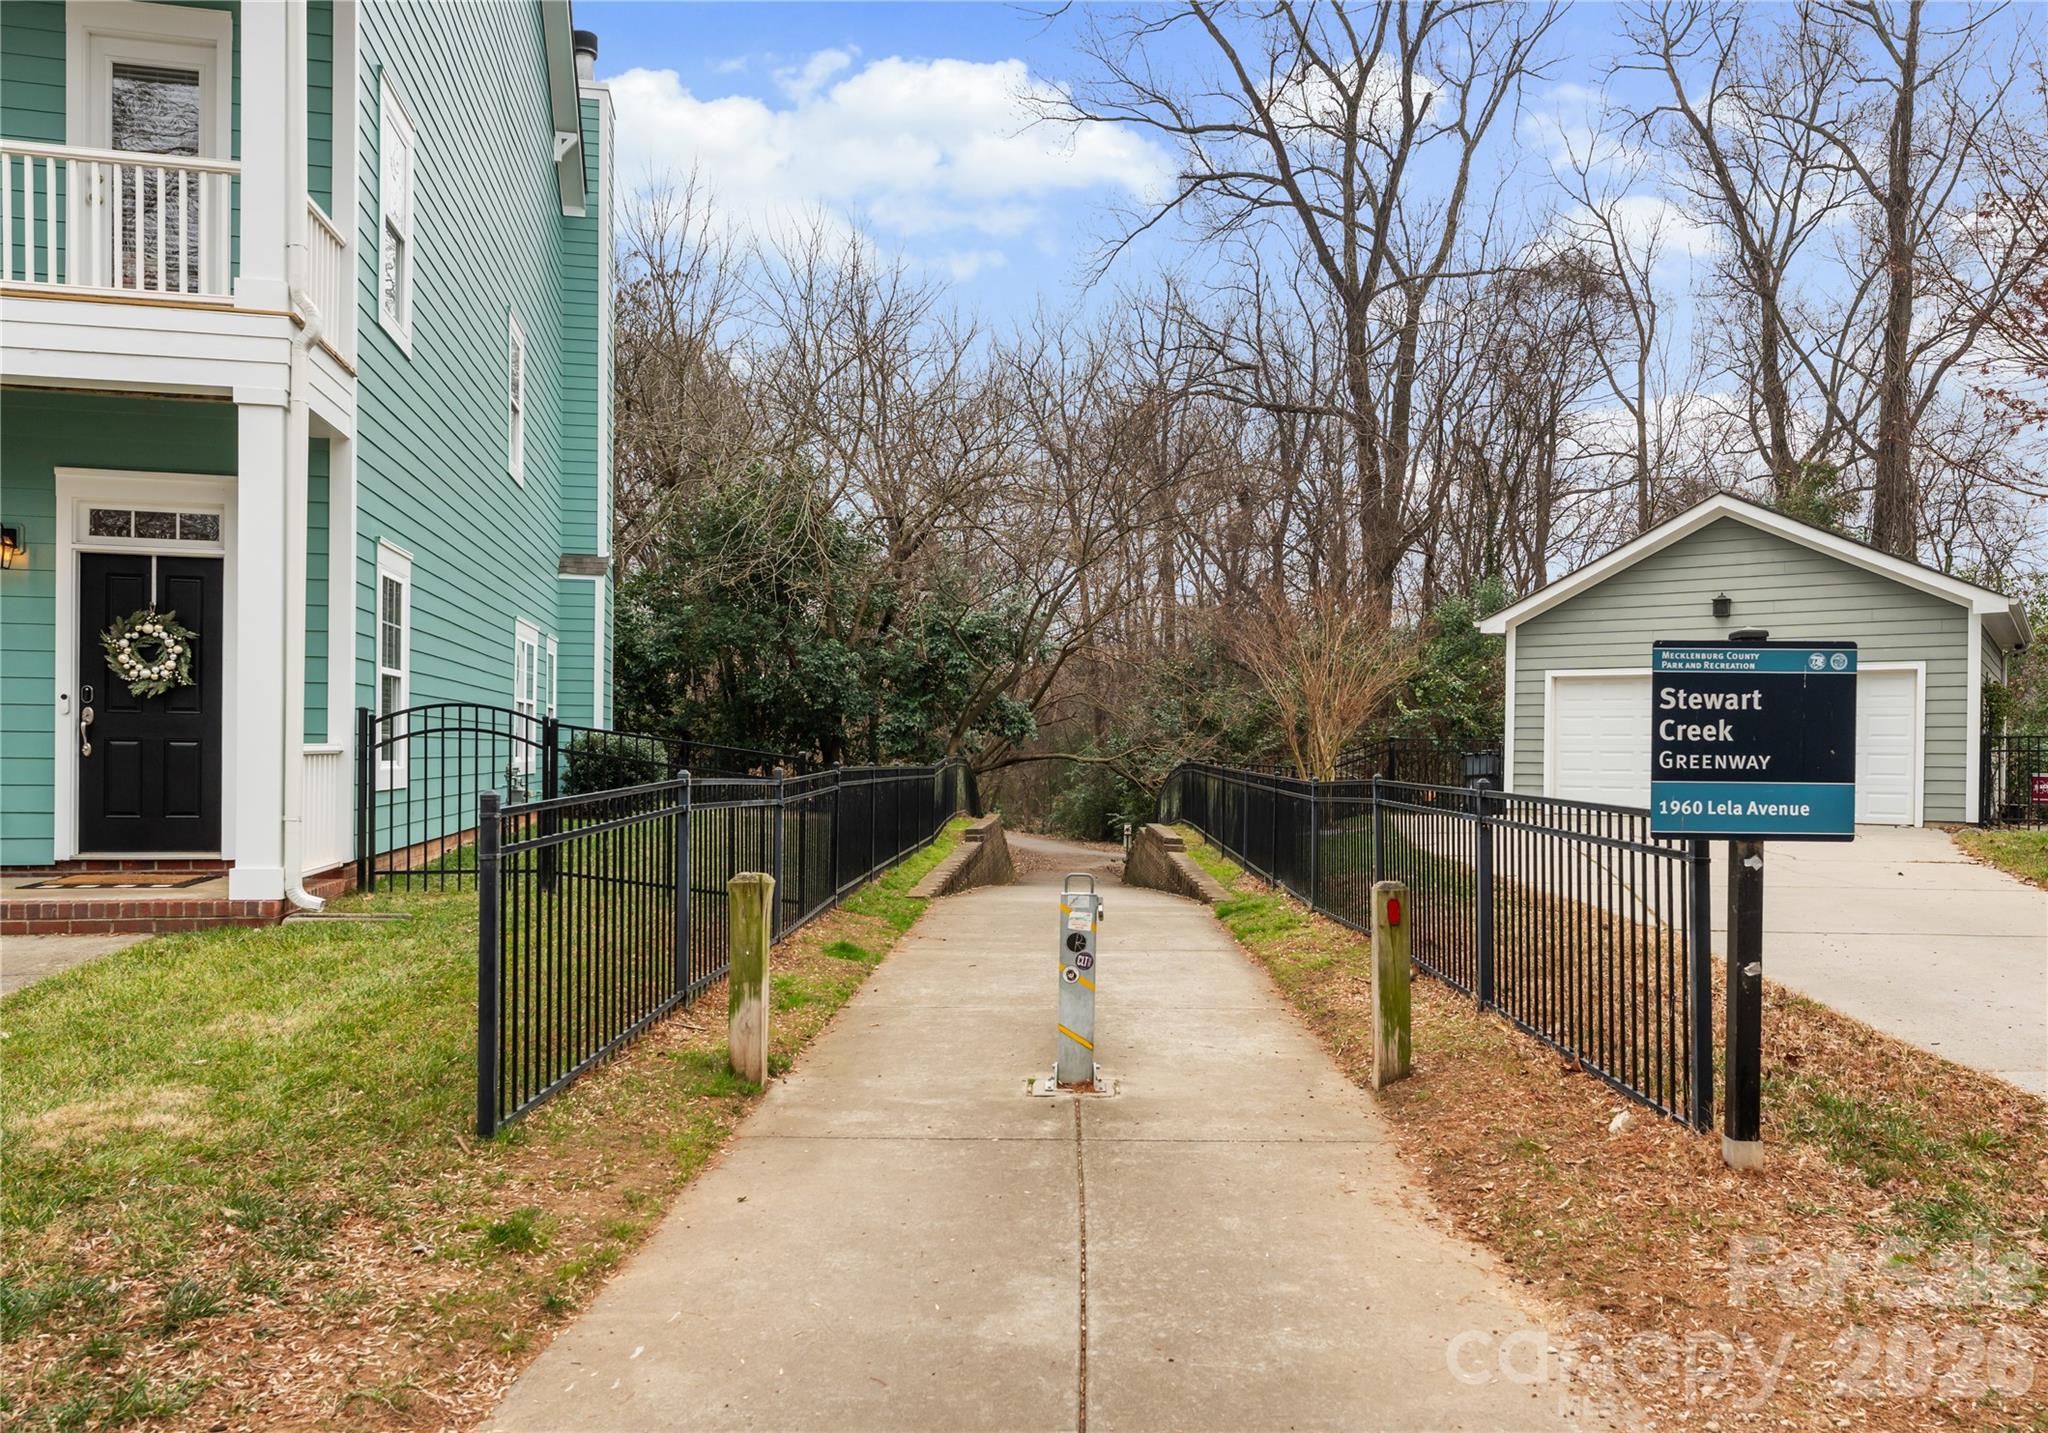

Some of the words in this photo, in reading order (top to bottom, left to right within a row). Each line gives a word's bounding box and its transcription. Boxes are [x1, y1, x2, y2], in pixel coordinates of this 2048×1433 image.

[1661, 651, 1724, 660] MECKLENBURG
[1726, 651, 1760, 660] COUNTY
[1661, 661, 1684, 669] PARK
[1703, 661, 1756, 670] RECREATION
[1659, 687, 1763, 710] Stewart
[1659, 718, 1735, 742] Creek
[1658, 750, 1772, 770] GREENWAY
[1659, 800, 1703, 816] 1960
[1707, 800, 1743, 816] Lela
[1746, 801, 1810, 816] Avenue
